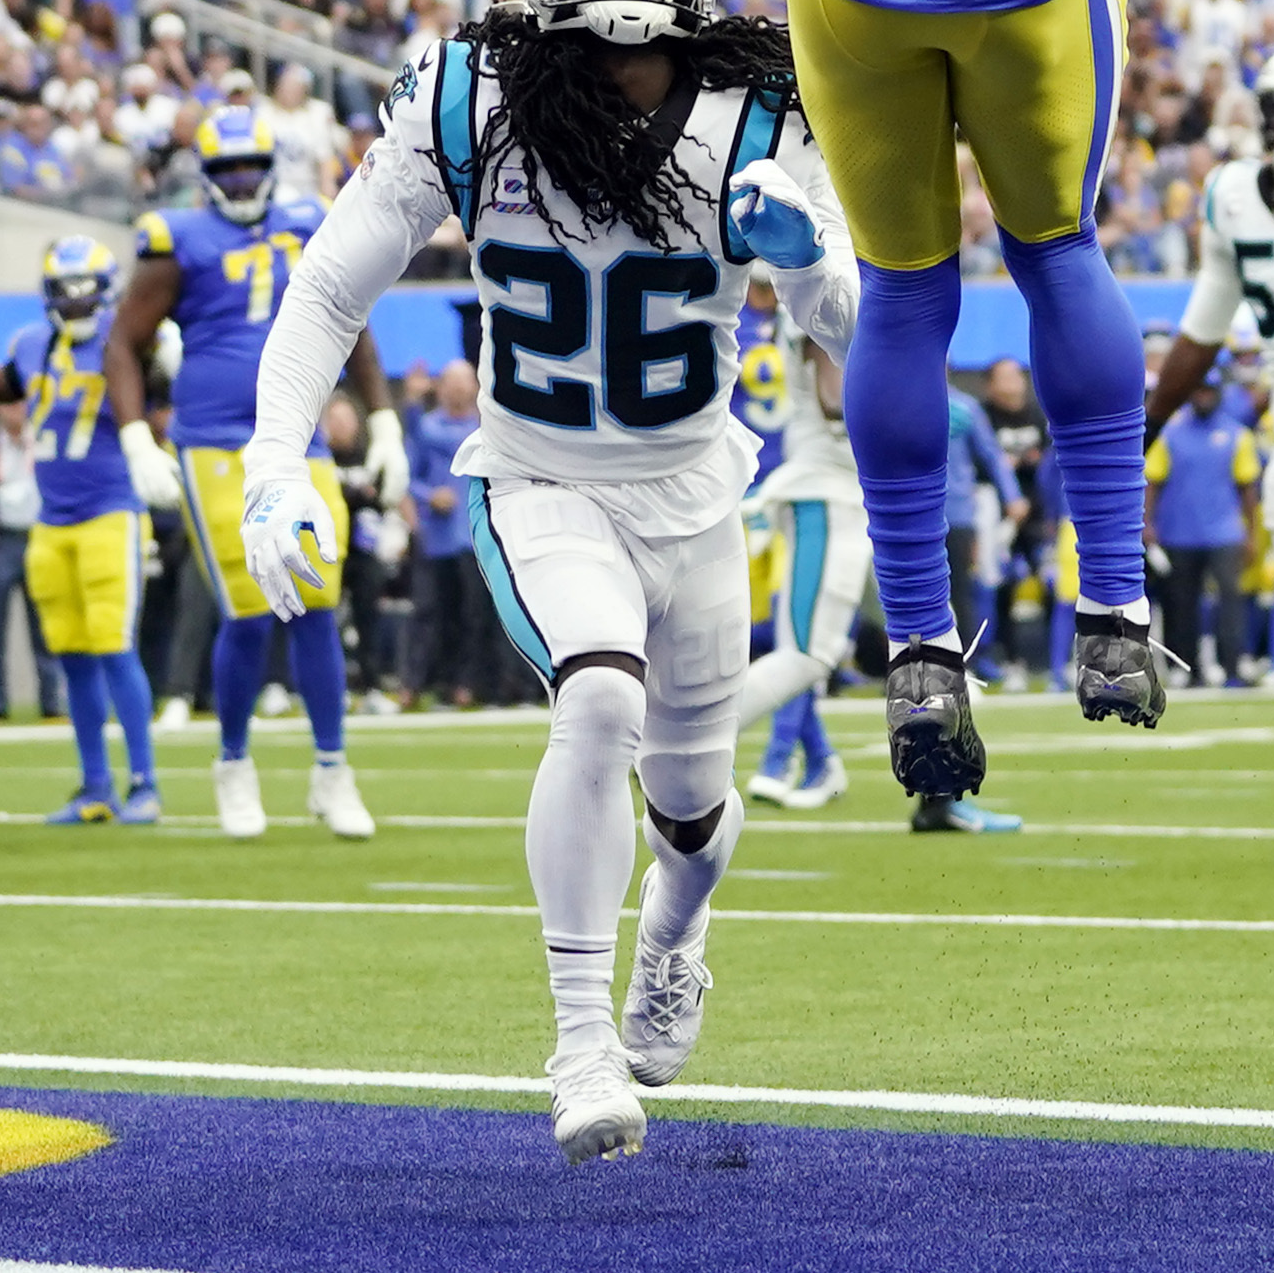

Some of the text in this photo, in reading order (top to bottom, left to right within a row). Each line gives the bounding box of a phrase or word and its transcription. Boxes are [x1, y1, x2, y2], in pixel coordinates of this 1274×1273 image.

[477, 238, 721, 430] 26
[28, 372, 106, 461] 27
[739, 342, 795, 432] 9
[246, 488, 287, 525] adida
